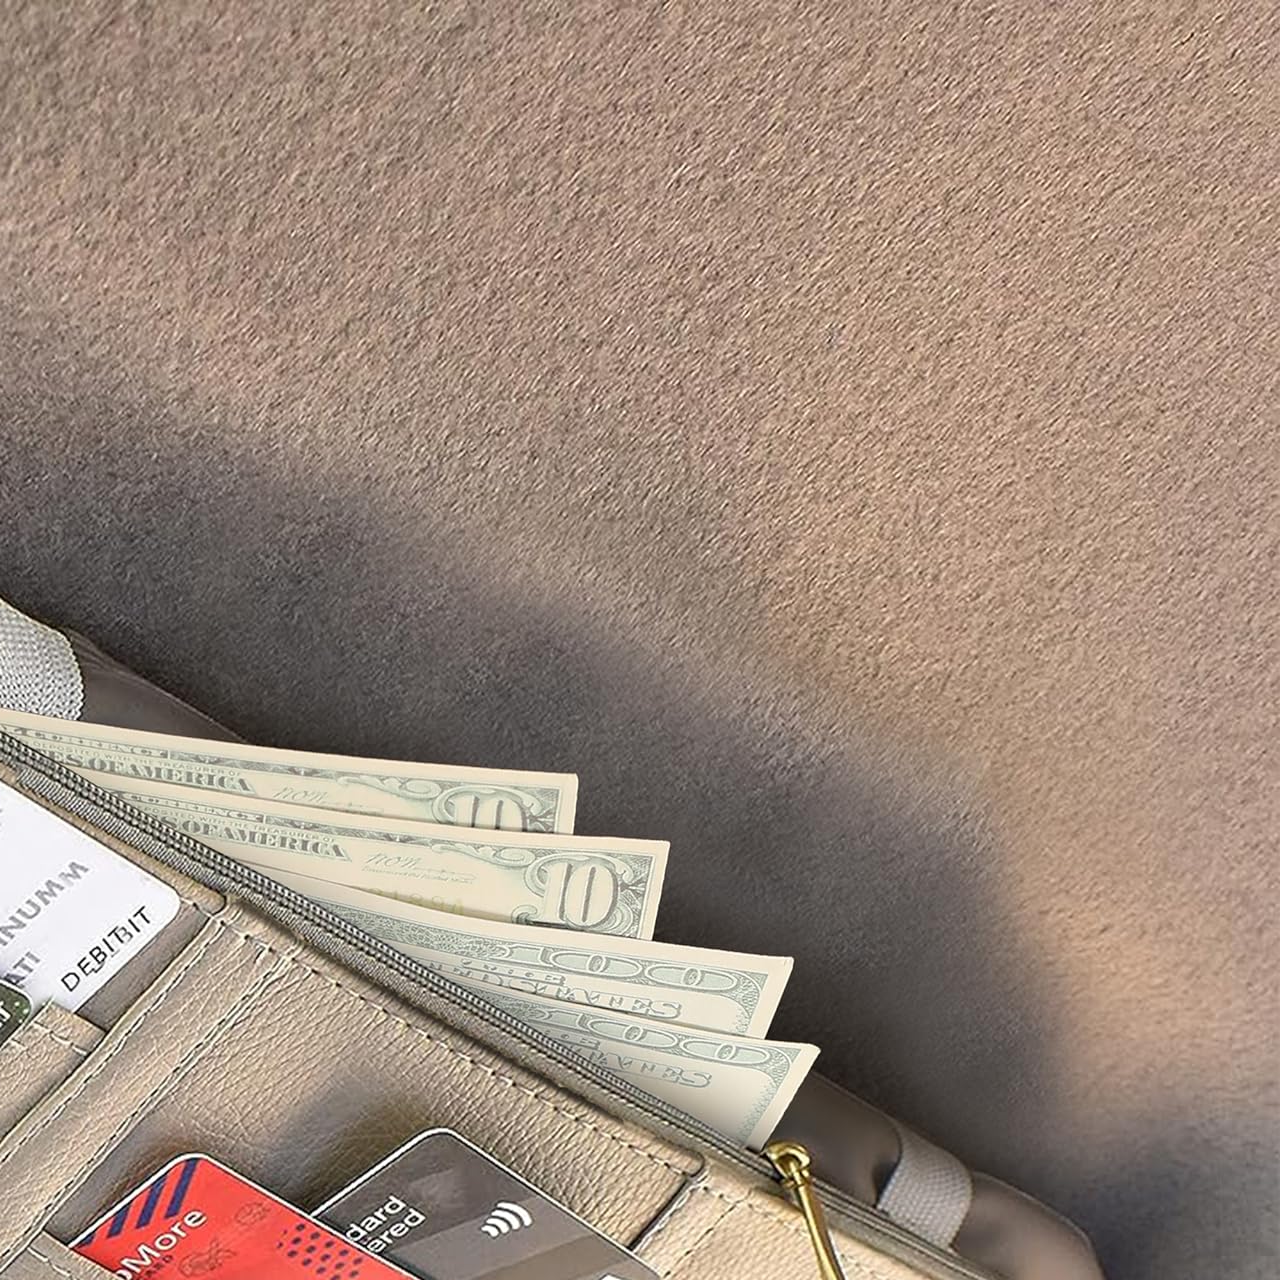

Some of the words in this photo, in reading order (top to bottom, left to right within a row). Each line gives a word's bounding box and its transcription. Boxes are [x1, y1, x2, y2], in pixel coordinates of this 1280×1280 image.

[124, 762, 257, 795] AMERICA
[223, 826, 353, 863] AMERICA
[540, 858, 620, 928] 10
